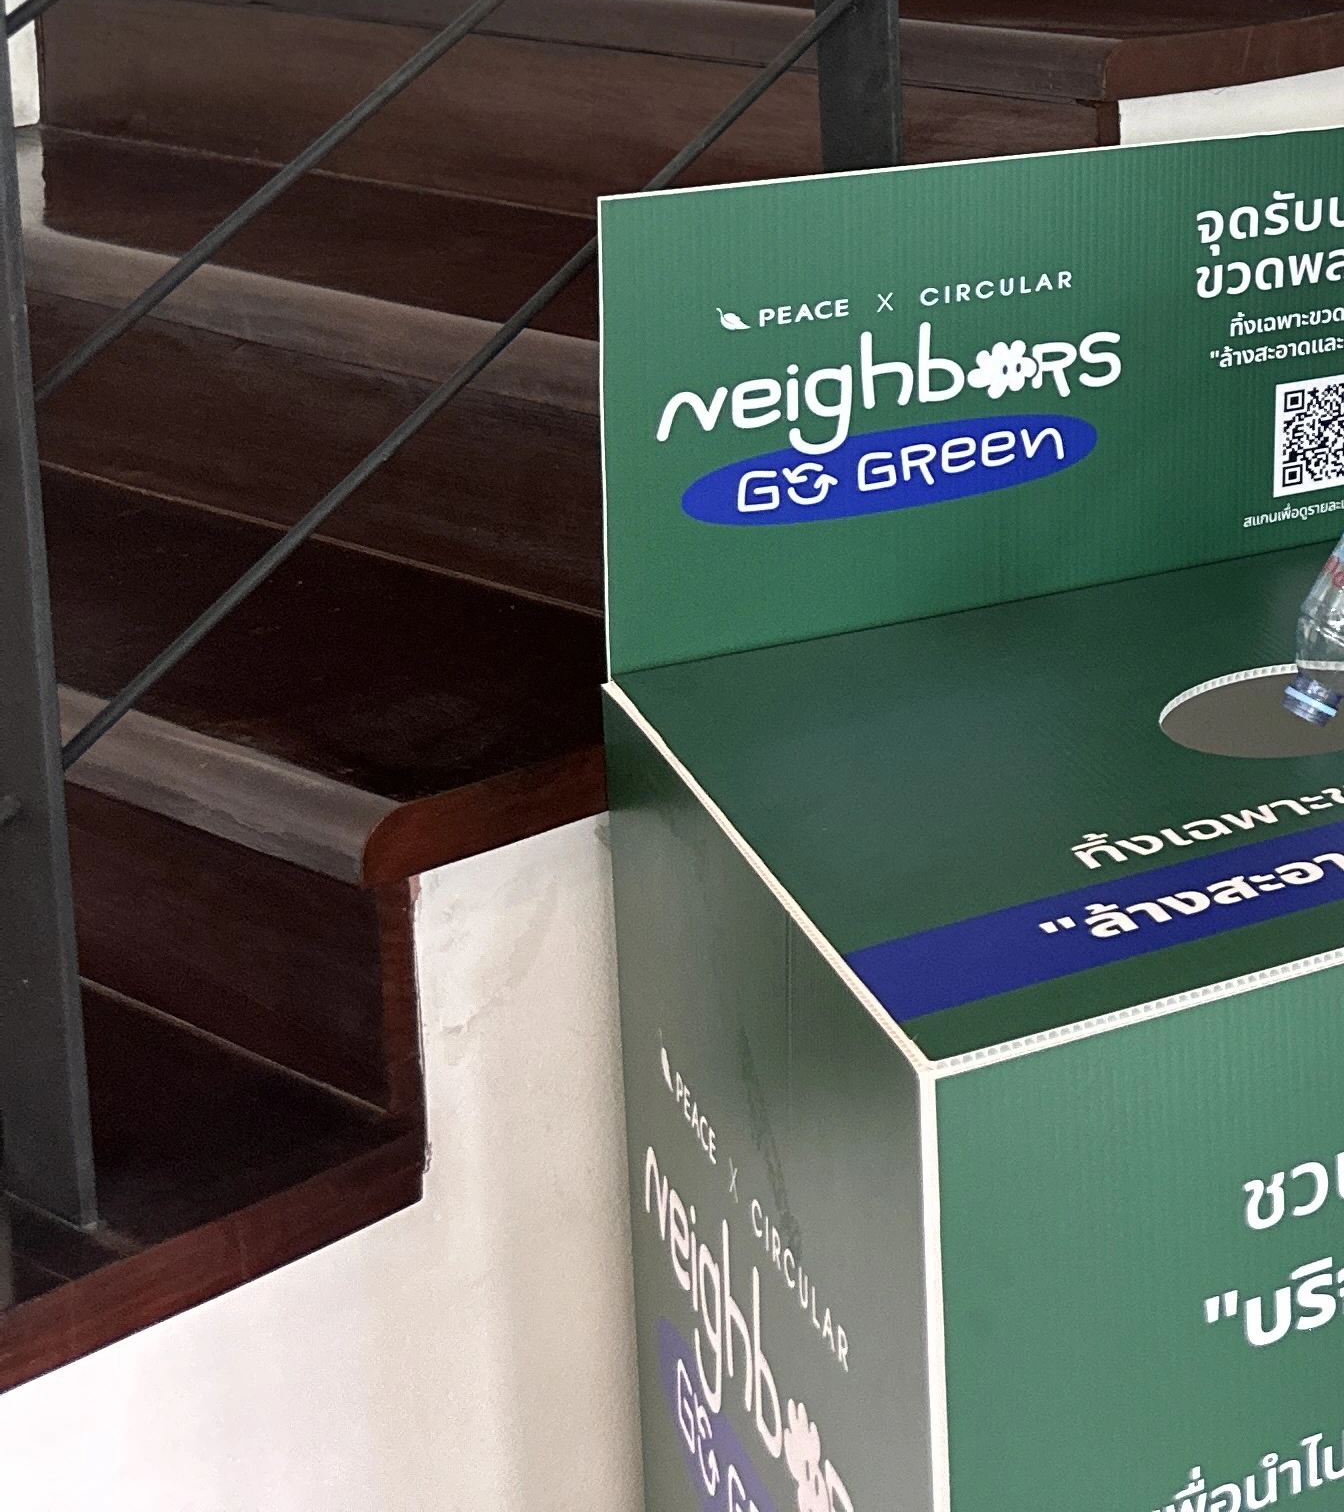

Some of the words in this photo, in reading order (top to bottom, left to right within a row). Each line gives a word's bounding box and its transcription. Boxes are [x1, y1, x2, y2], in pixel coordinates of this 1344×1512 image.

[760, 299, 849, 327] PEACE
[920, 271, 1071, 306] CIRCULAR
[676, 1072, 716, 1164] PEACE
[752, 1200, 848, 1371] CIRCULAR
